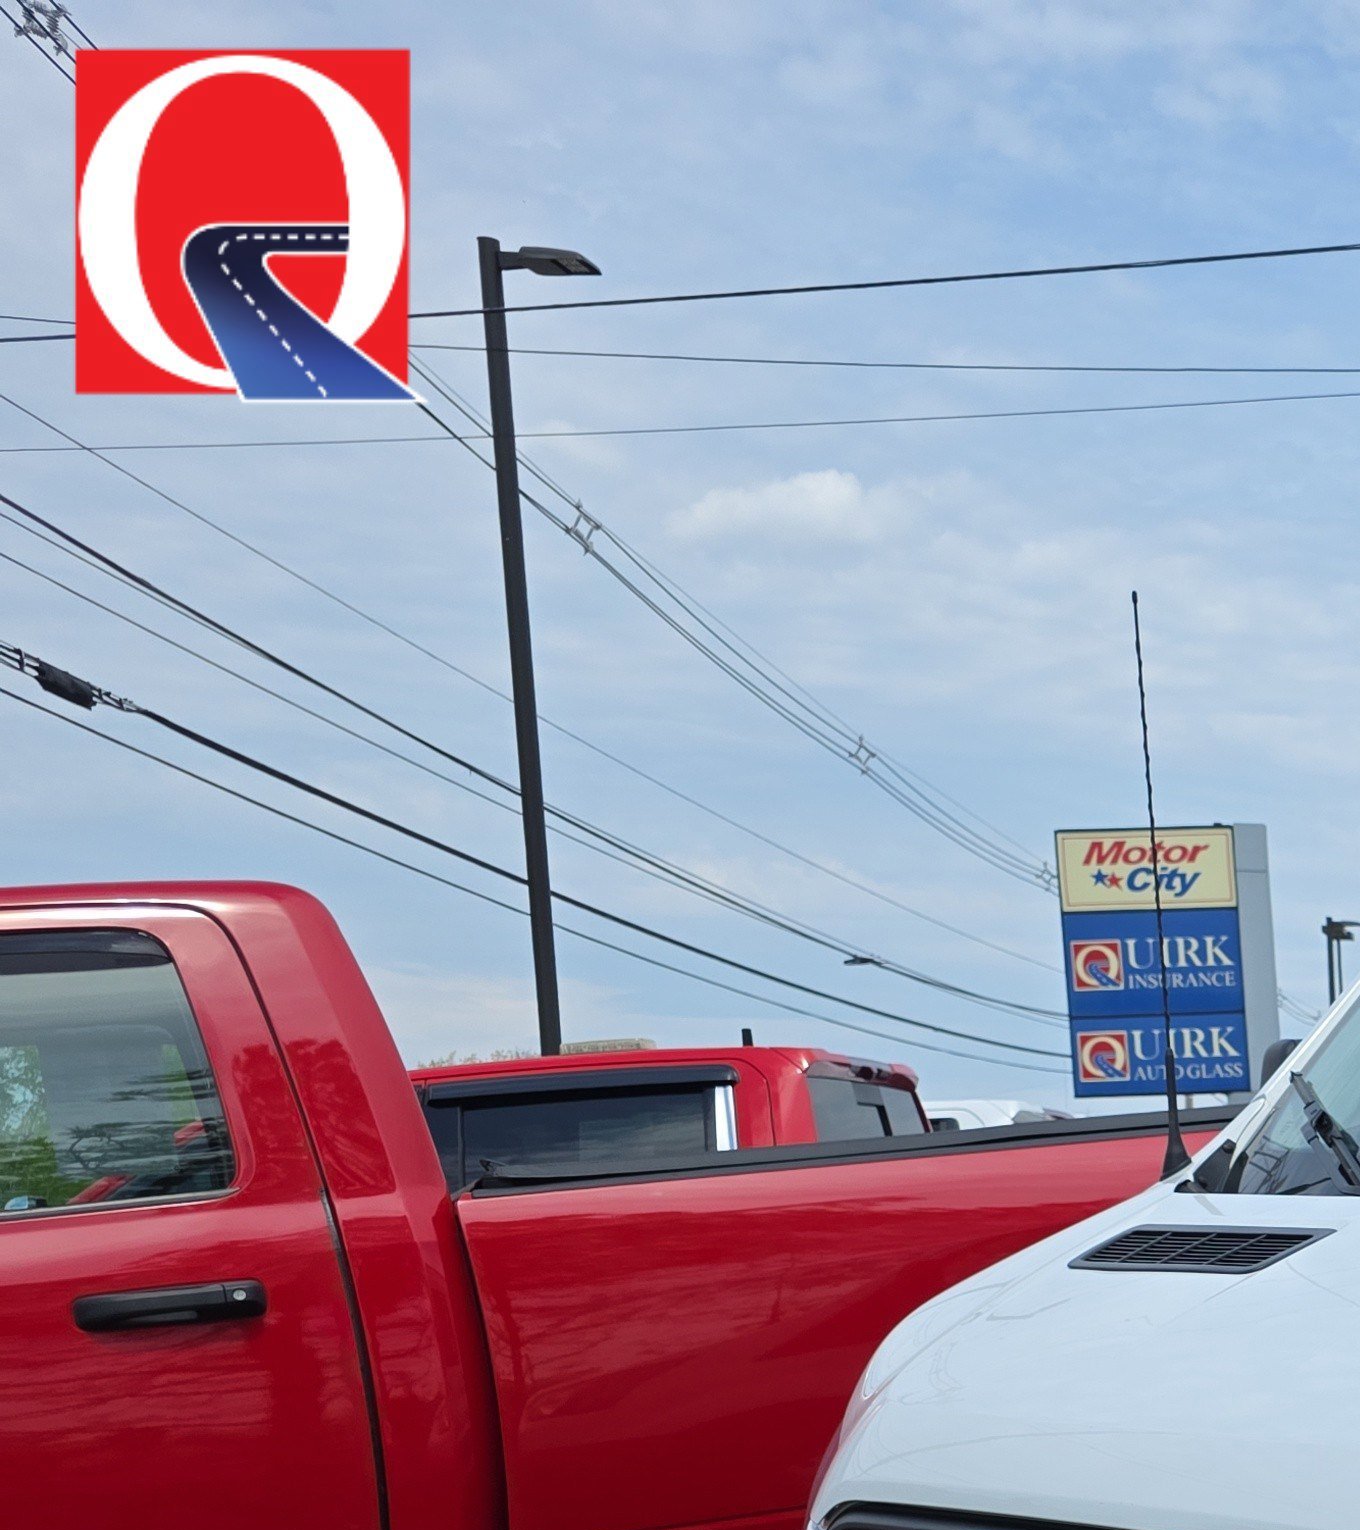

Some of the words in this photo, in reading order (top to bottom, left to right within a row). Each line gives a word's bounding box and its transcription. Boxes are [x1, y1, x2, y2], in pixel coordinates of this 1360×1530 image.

[1082, 841, 1211, 867] Motor
[1126, 867, 1201, 897] City
[1073, 935, 1236, 989] QUIRK
[1128, 970, 1236, 990] INSURANCE
[1080, 1026, 1240, 1079] QUIRK
